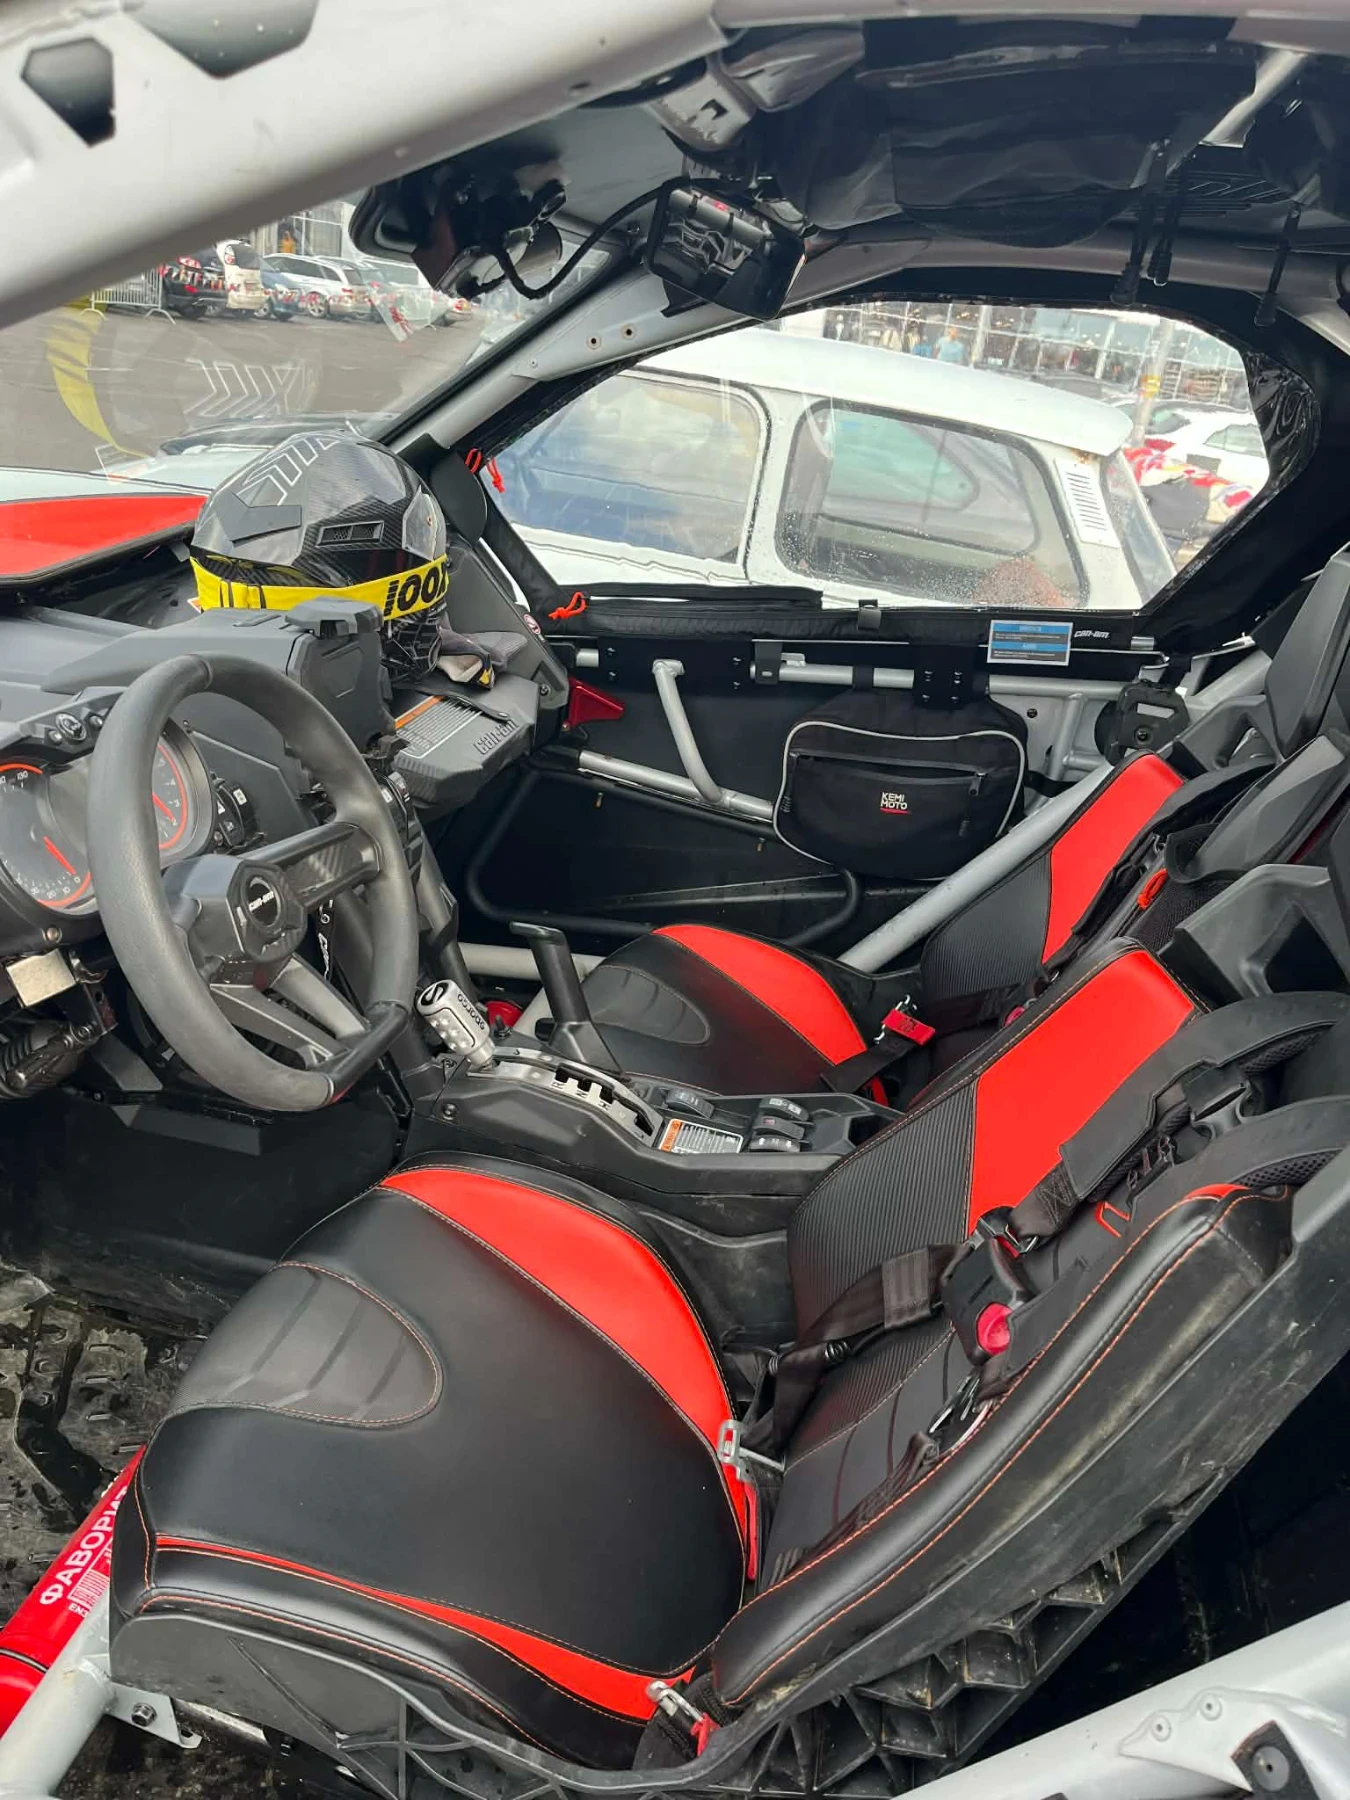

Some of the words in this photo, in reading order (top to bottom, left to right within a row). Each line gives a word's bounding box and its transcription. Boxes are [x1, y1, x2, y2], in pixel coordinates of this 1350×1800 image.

[881, 791, 905, 802] KEMI
[880, 800, 908, 810] MOTO
[457, 993, 485, 1031] sparco
